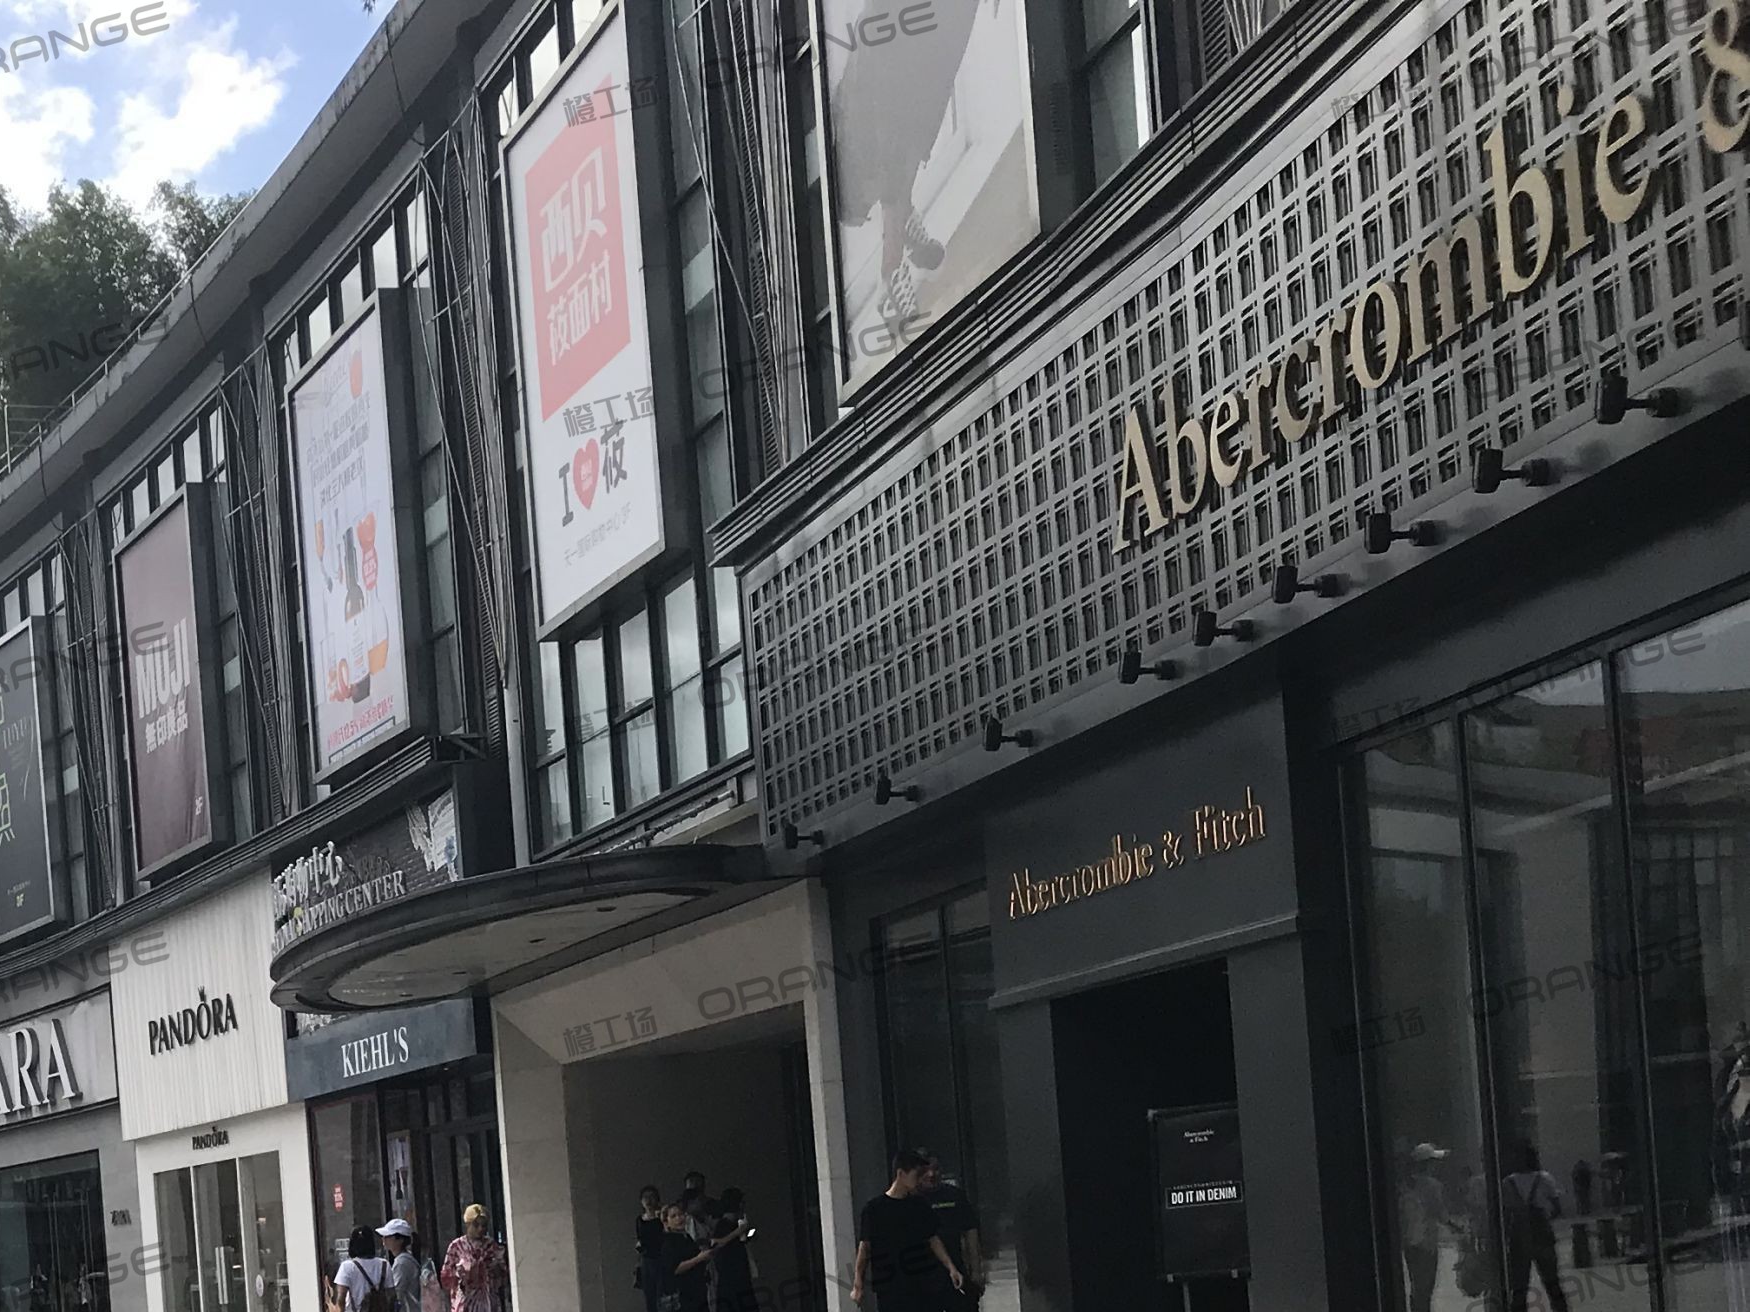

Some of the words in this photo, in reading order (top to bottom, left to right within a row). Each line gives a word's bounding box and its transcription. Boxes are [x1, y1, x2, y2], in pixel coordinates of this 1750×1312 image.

[547, 250, 612, 366] 莜面村
[1112, 84, 1650, 555] Abercrombie
[135, 617, 191, 719] MUJI
[145, 699, 188, 754] 無印良品
[1008, 832, 1154, 920] Abercrombie
[1161, 829, 1186, 869] &
[1192, 785, 1266, 860] Fitch
[344, 870, 406, 914] CENTER
[148, 988, 239, 1056] PANDORA
[341, 1026, 410, 1078] KIEHL'S
[192, 1128, 230, 1150] PANDORA
[1171, 1192, 1184, 1205] DO
[1186, 1190, 1194, 1203] IT
[1196, 1189, 1206, 1202] IN
[1207, 1186, 1237, 1201] DENIM
